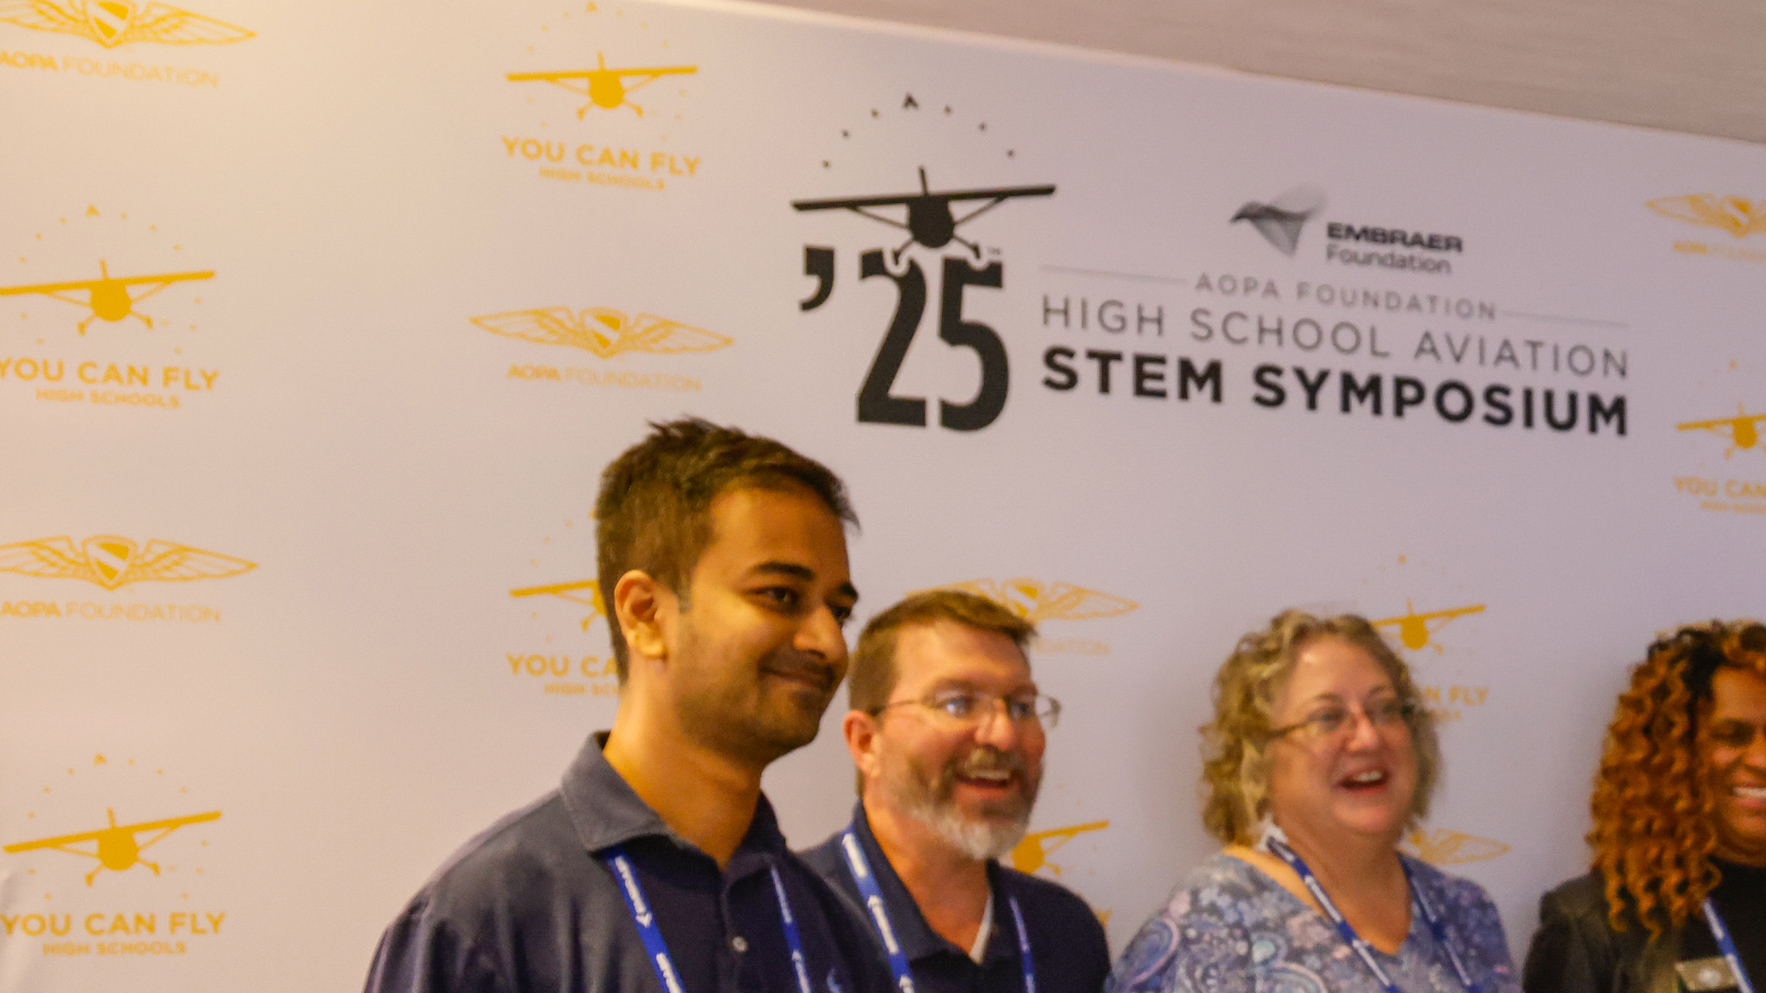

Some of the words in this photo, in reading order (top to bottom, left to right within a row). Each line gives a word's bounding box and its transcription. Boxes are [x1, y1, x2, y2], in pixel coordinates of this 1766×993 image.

[0, 51, 58, 72] AOPA
[62, 55, 219, 88] FOUNDATION
[501, 134, 565, 163] YOU
[576, 143, 640, 170] CAN
[651, 151, 701, 176] FLY
[1327, 222, 1464, 254] EMBRAER
[1326, 243, 1451, 274] Foundation
[1195, 272, 1278, 298] AOPA
[1298, 283, 1496, 320] FOUNDATION
[1041, 294, 1165, 336] HIGH
[1190, 308, 1390, 358] SCHOOL
[1414, 331, 1628, 378] AVIATION
[0, 357, 64, 382] YOU
[77, 361, 149, 386] CAN
[162, 366, 219, 391] FLY
[506, 363, 561, 382] AOPA
[36, 388, 84, 402] HIGH
[89, 390, 180, 409] SCHOOLS
[1042, 346, 1223, 405] STEM
[1253, 364, 1628, 437] SYMPOSIUM
[1674, 477, 1718, 497] YOU
[0, 601, 61, 618] AOPA
[66, 602, 221, 622] FOUNDATION
[506, 653, 569, 678] YOU
[580, 656, 620, 678] CA
[0, 913, 72, 936] YOU
[84, 912, 156, 936] CAN
[168, 911, 226, 935] FLY
[43, 942, 90, 956] HIGH
[97, 941, 187, 956] SCHOOLS
